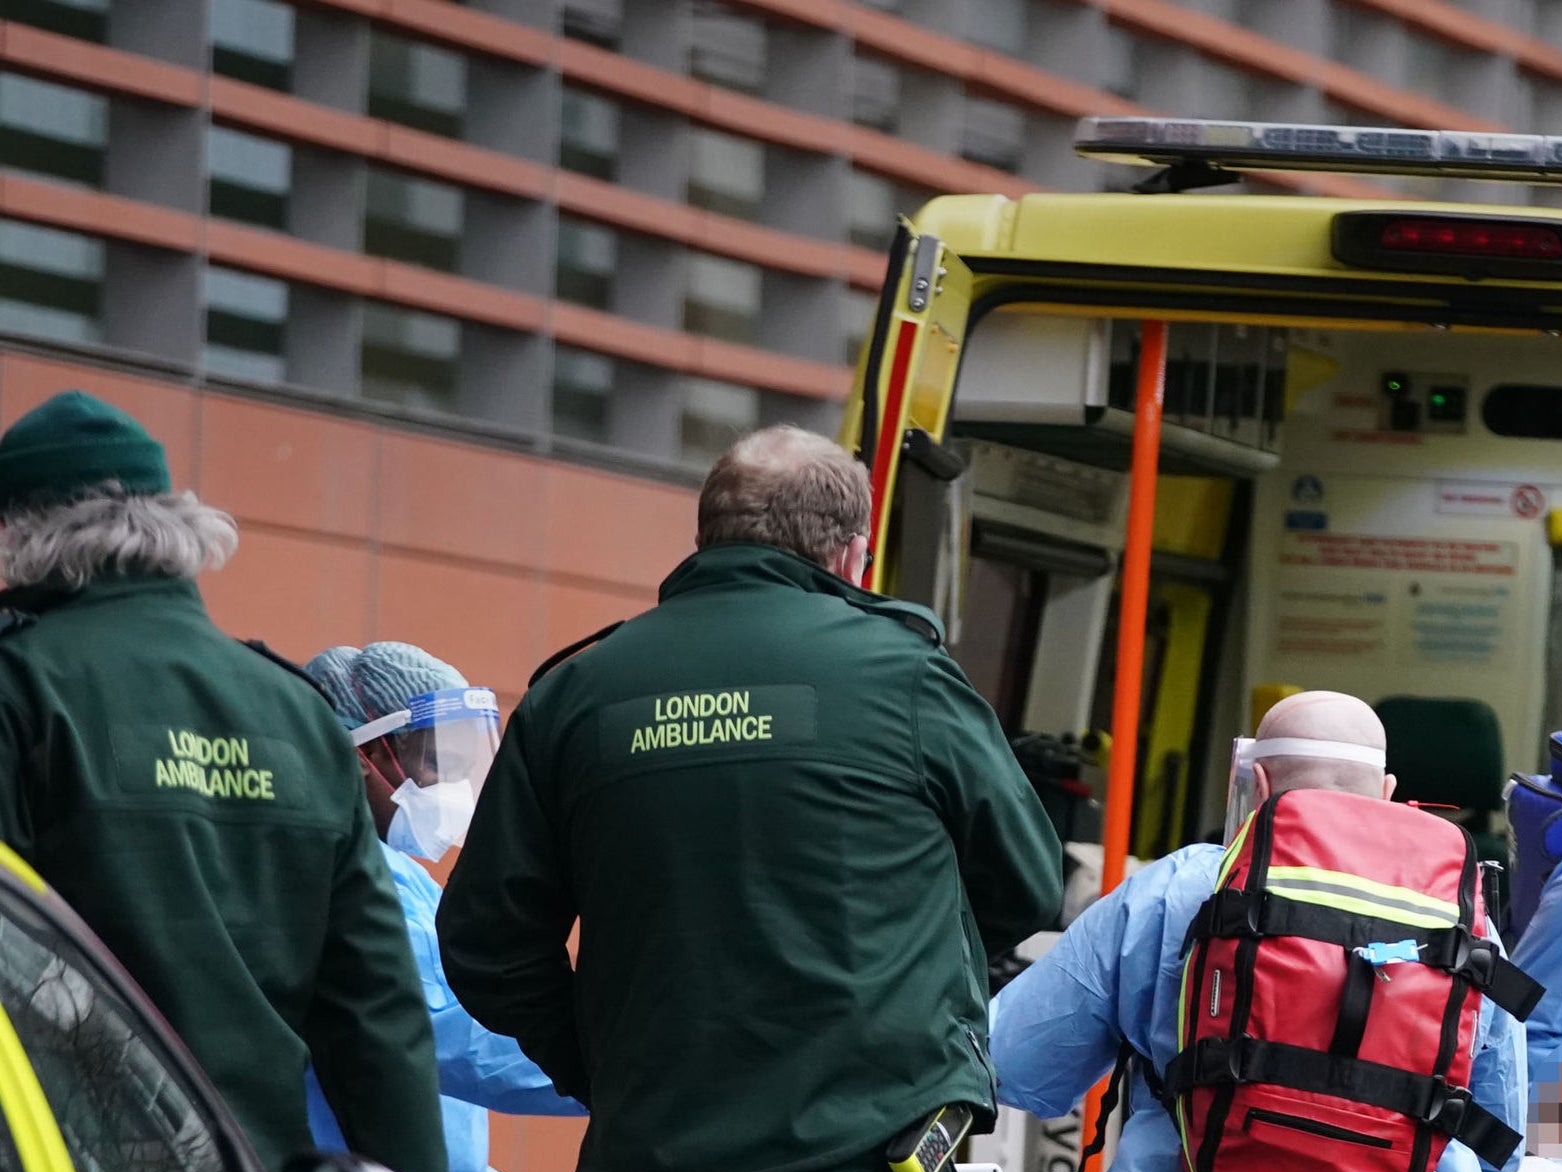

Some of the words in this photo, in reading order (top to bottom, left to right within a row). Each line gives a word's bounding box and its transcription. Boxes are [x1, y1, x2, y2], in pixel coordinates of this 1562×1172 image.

[655, 690, 750, 721] LONDON
[630, 715, 773, 754] AMBULANCE
[156, 758, 276, 800] AMBLANCE
